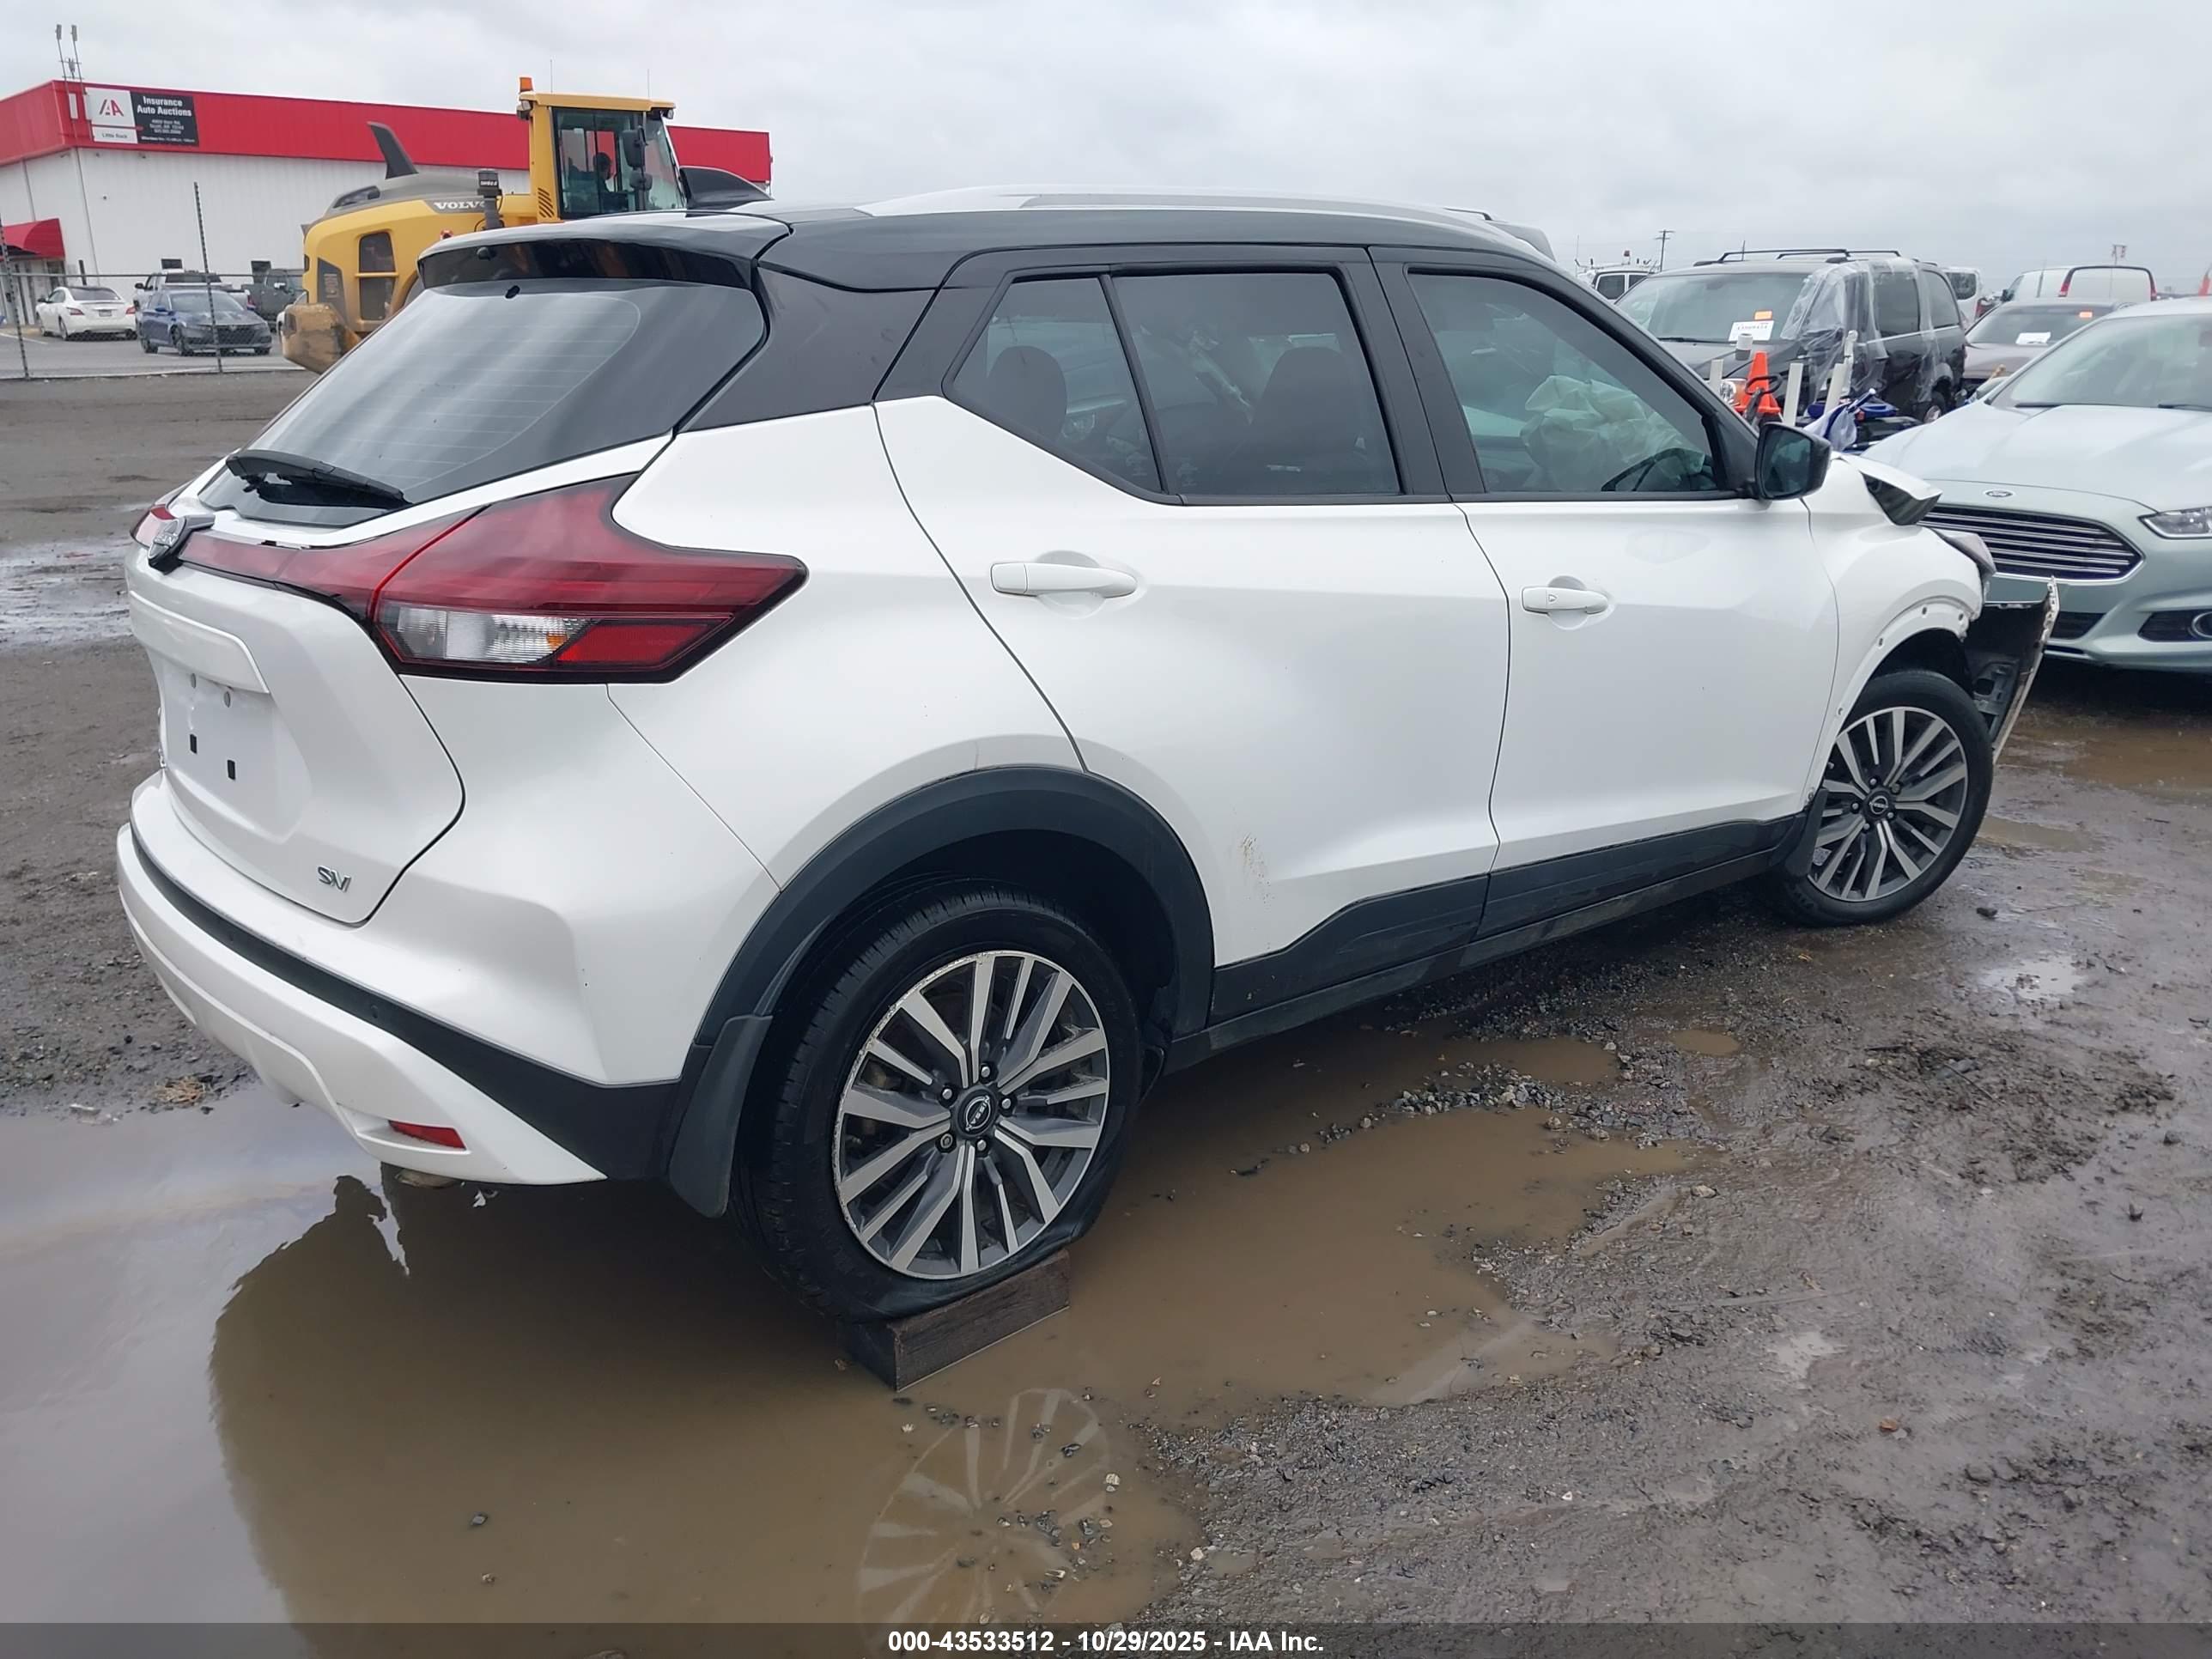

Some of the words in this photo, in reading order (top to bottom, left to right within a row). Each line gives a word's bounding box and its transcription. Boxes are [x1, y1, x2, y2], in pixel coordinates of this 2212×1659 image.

[143, 96, 183, 106] Insurance
[137, 105, 156, 114] Auto
[157, 106, 192, 117] Auctions
[318, 865, 352, 892] SV
[965, 1095, 990, 1132] NISSAN
